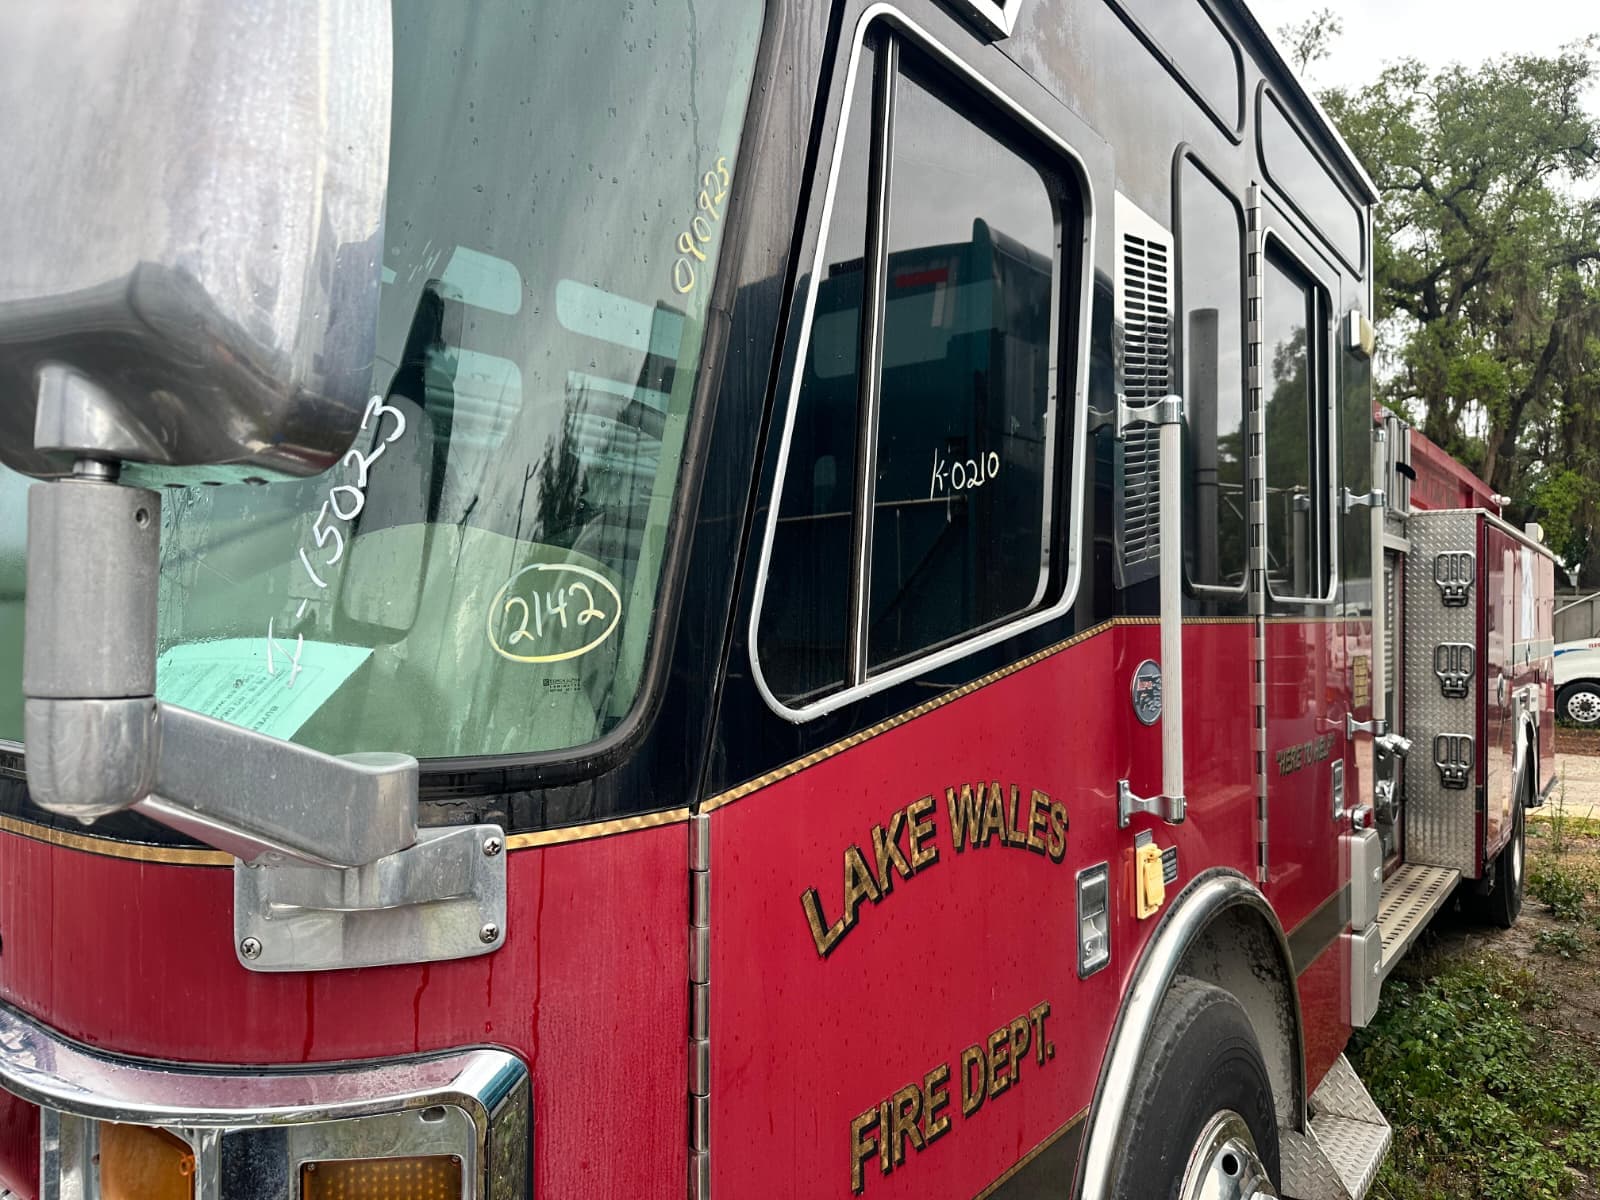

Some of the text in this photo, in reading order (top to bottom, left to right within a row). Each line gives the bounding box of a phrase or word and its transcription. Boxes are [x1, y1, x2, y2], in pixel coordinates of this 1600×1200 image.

[675, 156, 730, 293] 090925
[930, 447, 1000, 502] K-0210
[504, 581, 606, 645] 2142
[801, 780, 1069, 959] LAKE WALES
[850, 1000, 1056, 1195] FIRE DEPT.
